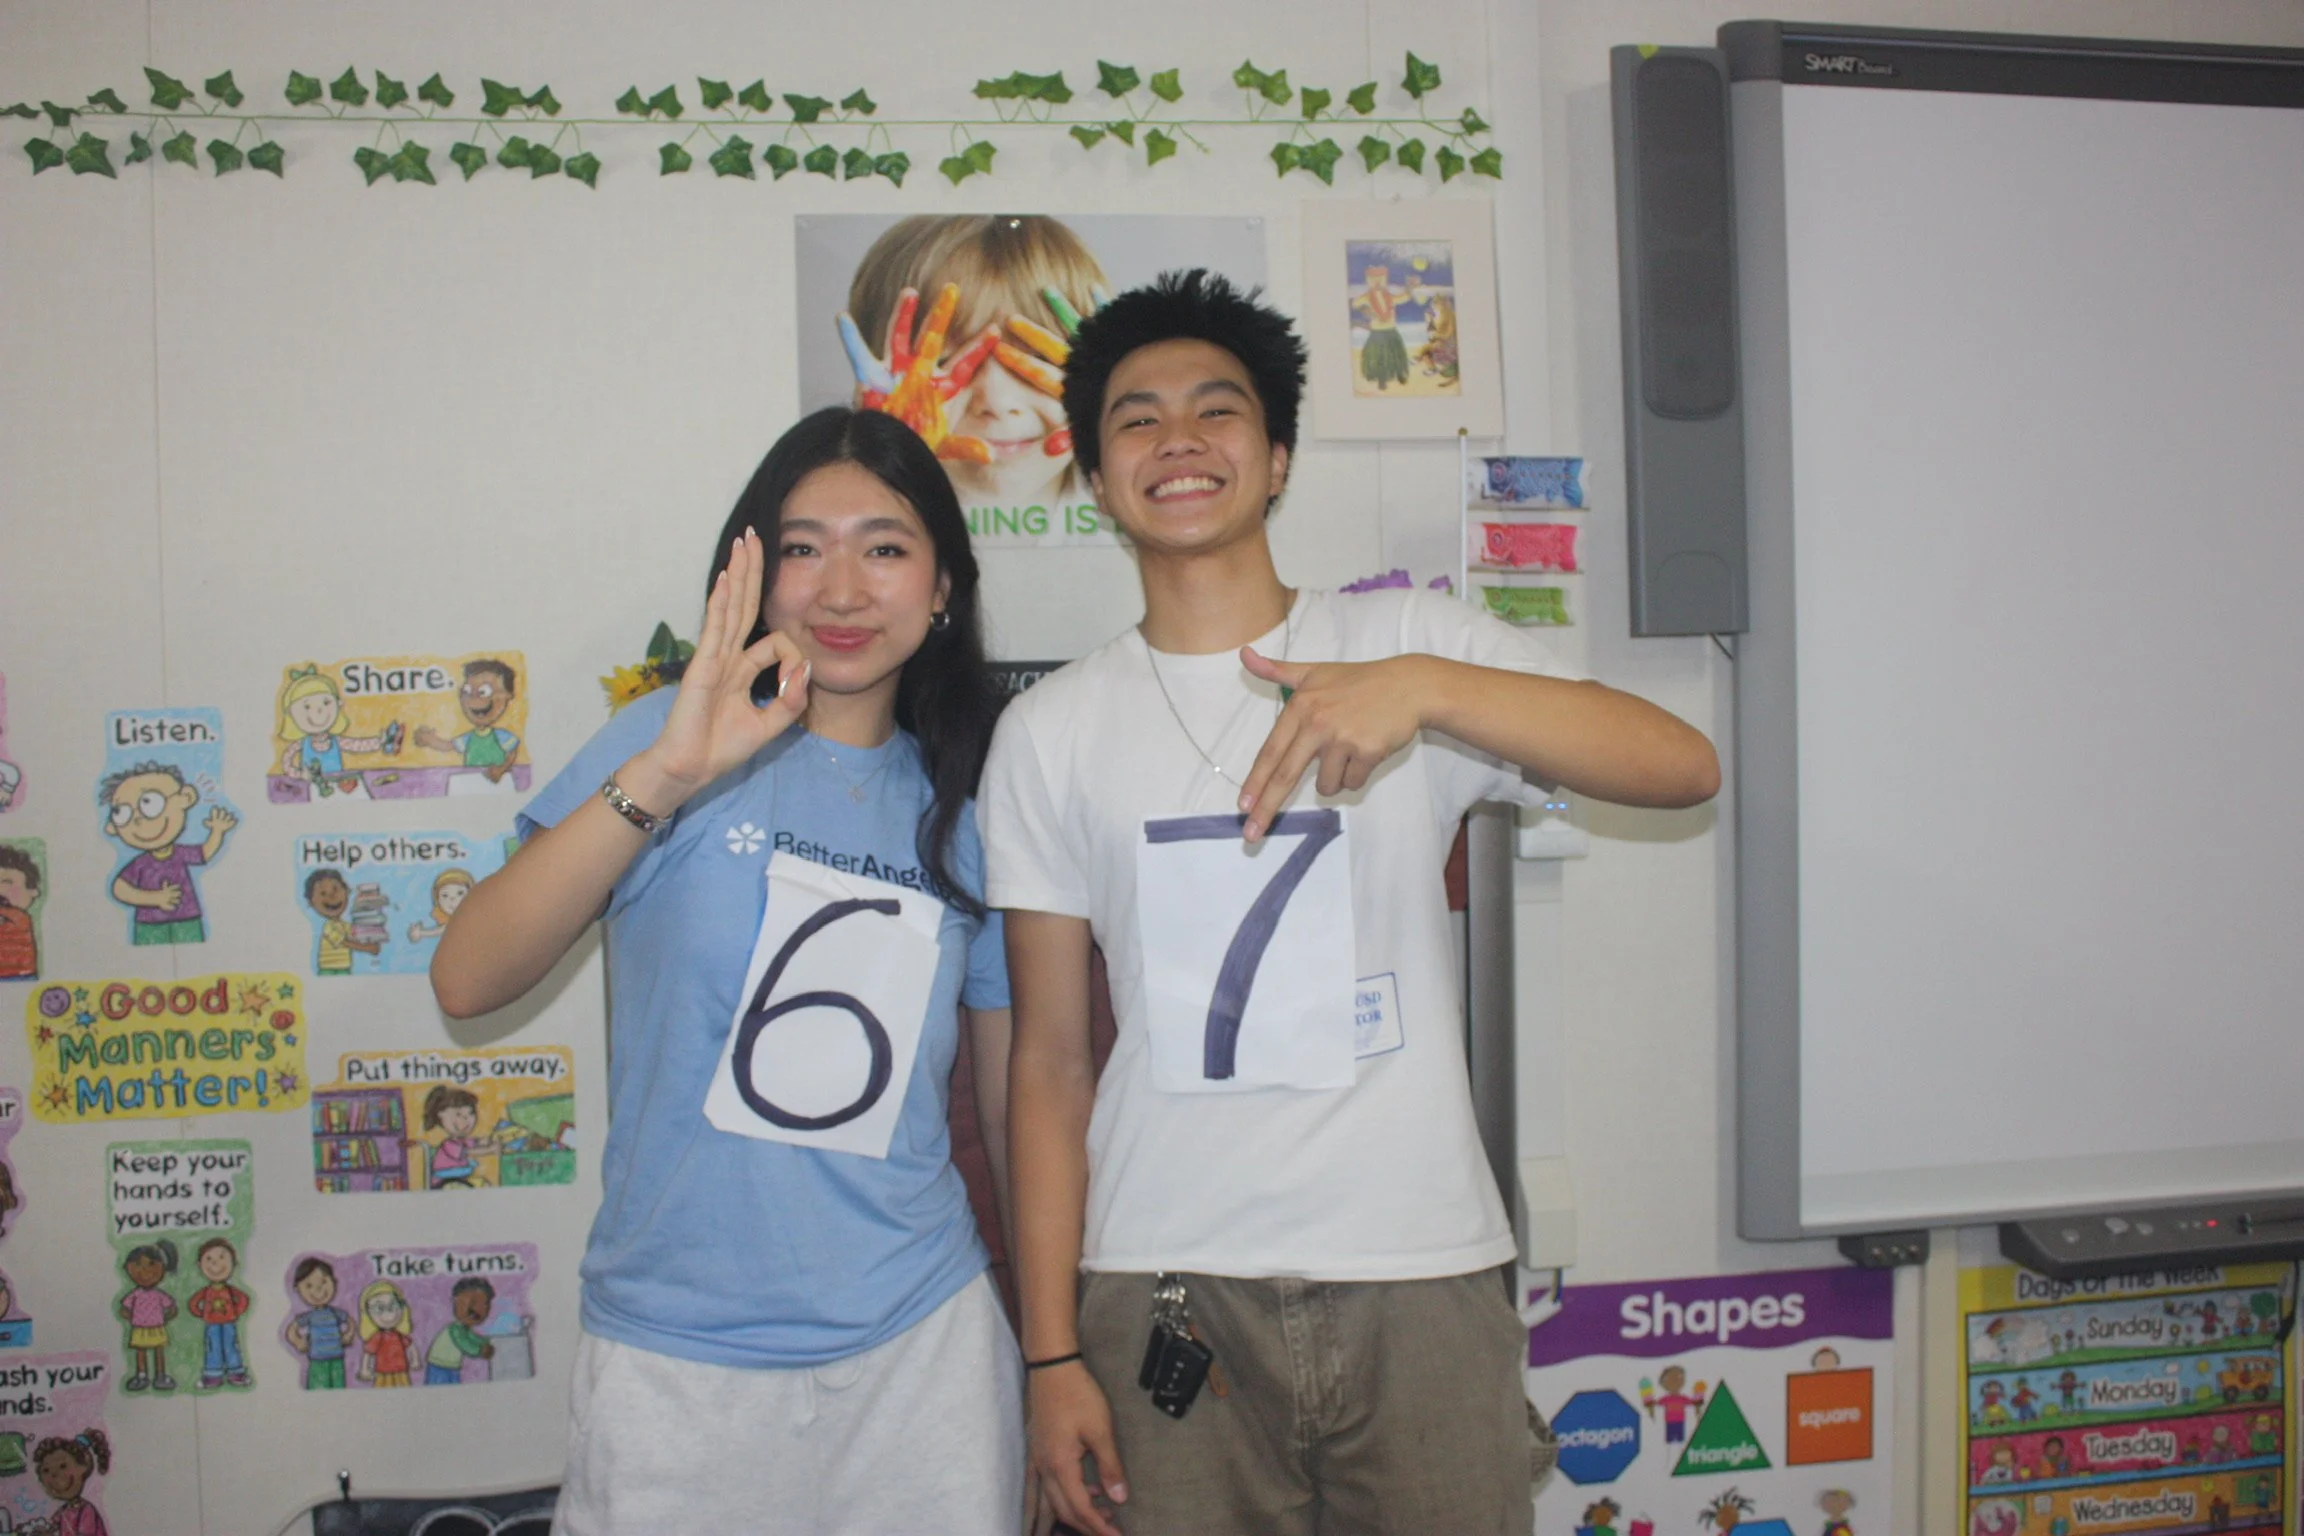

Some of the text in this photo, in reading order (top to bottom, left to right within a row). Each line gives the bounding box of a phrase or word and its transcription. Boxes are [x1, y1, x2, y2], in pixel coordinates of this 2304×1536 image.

[1804, 53, 1858, 73] SMART
[1064, 504, 1099, 535] IS
[343, 664, 455, 694] Share.
[114, 717, 217, 745] Listen.
[303, 836, 467, 869] Help others.
[1144, 807, 1343, 1081] 7
[100, 976, 229, 1021] Good
[731, 898, 901, 1132] 6
[58, 1026, 277, 1074] Manners
[346, 1055, 565, 1084] Put things away.
[75, 1066, 269, 1116] Matter!
[113, 1150, 247, 1177] Keep your
[114, 1179, 231, 1201] hands to
[115, 1202, 229, 1234] yourself.
[371, 1251, 524, 1276] Take turns.
[2018, 1272, 2077, 1301] Days
[1619, 1291, 1807, 1345] Shapes
[2086, 1312, 2164, 1341] Sunday
[45, 1364, 105, 1389] your
[2091, 1375, 2178, 1405] Monday
[1798, 1406, 1862, 1429] square
[1556, 1426, 1635, 1450] octagon
[1687, 1440, 1760, 1466] triangle
[2083, 1430, 2175, 1461] Tuesday
[2073, 1490, 2195, 1523] Wednesday
